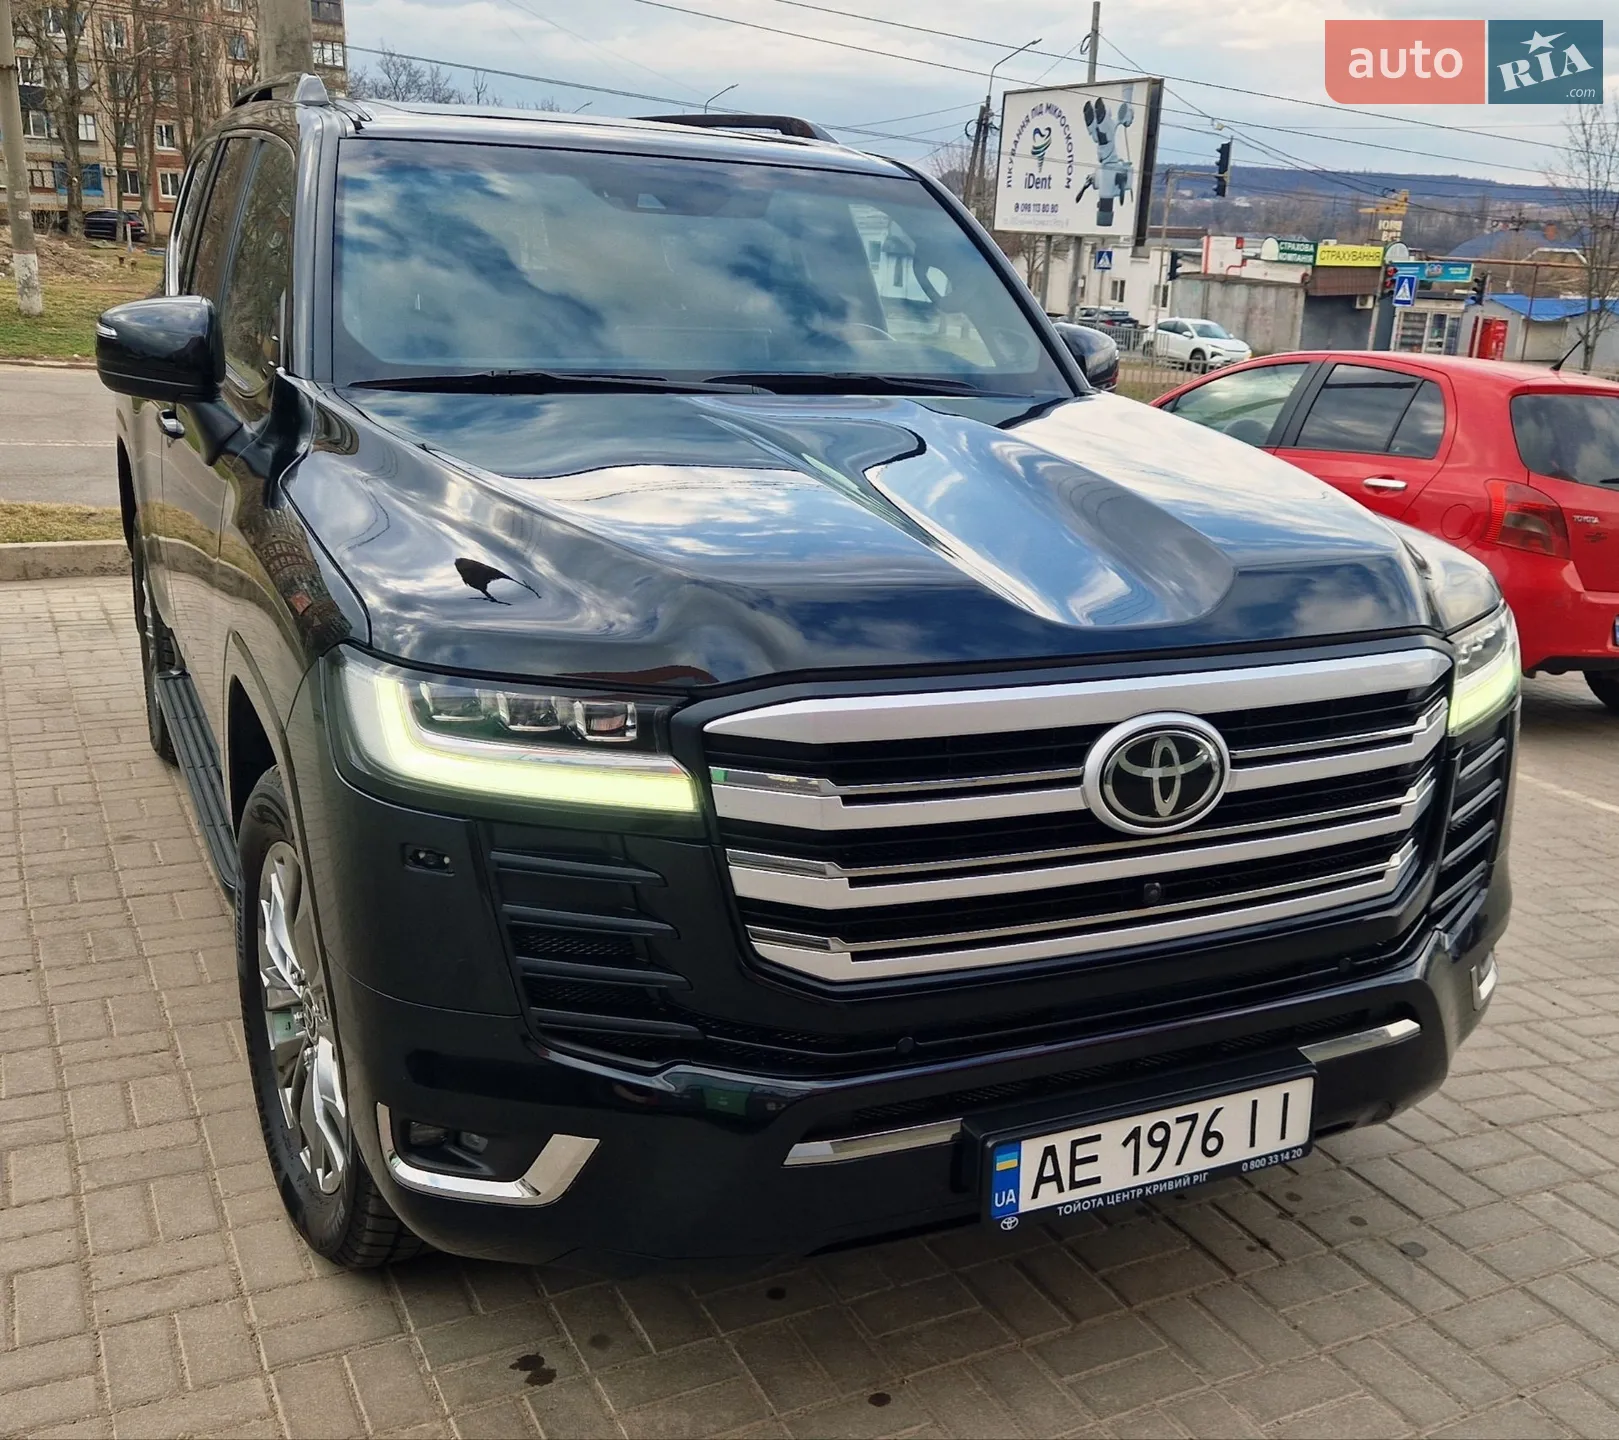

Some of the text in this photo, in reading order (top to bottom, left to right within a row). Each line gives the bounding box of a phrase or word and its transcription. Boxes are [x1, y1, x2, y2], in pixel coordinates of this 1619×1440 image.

[1024, 172, 1052, 190] iDent
[1319, 249, 1381, 262] СТРАХУВАННЯ
[1572, 515, 1600, 524] TOYOTA
[1030, 1133, 1102, 1200] AE
[1120, 1106, 1225, 1177] 1976
[1249, 1157, 1267, 1170] 800
[1267, 1153, 1279, 1165] 33
[1280, 1150, 1290, 1161] 14
[1291, 1147, 1303, 1159] 20
[994, 1188, 1017, 1208] UA
[1057, 1172, 1209, 1216] ТОЙОТА ЦЕНТР КРИВИЙ РІГ
